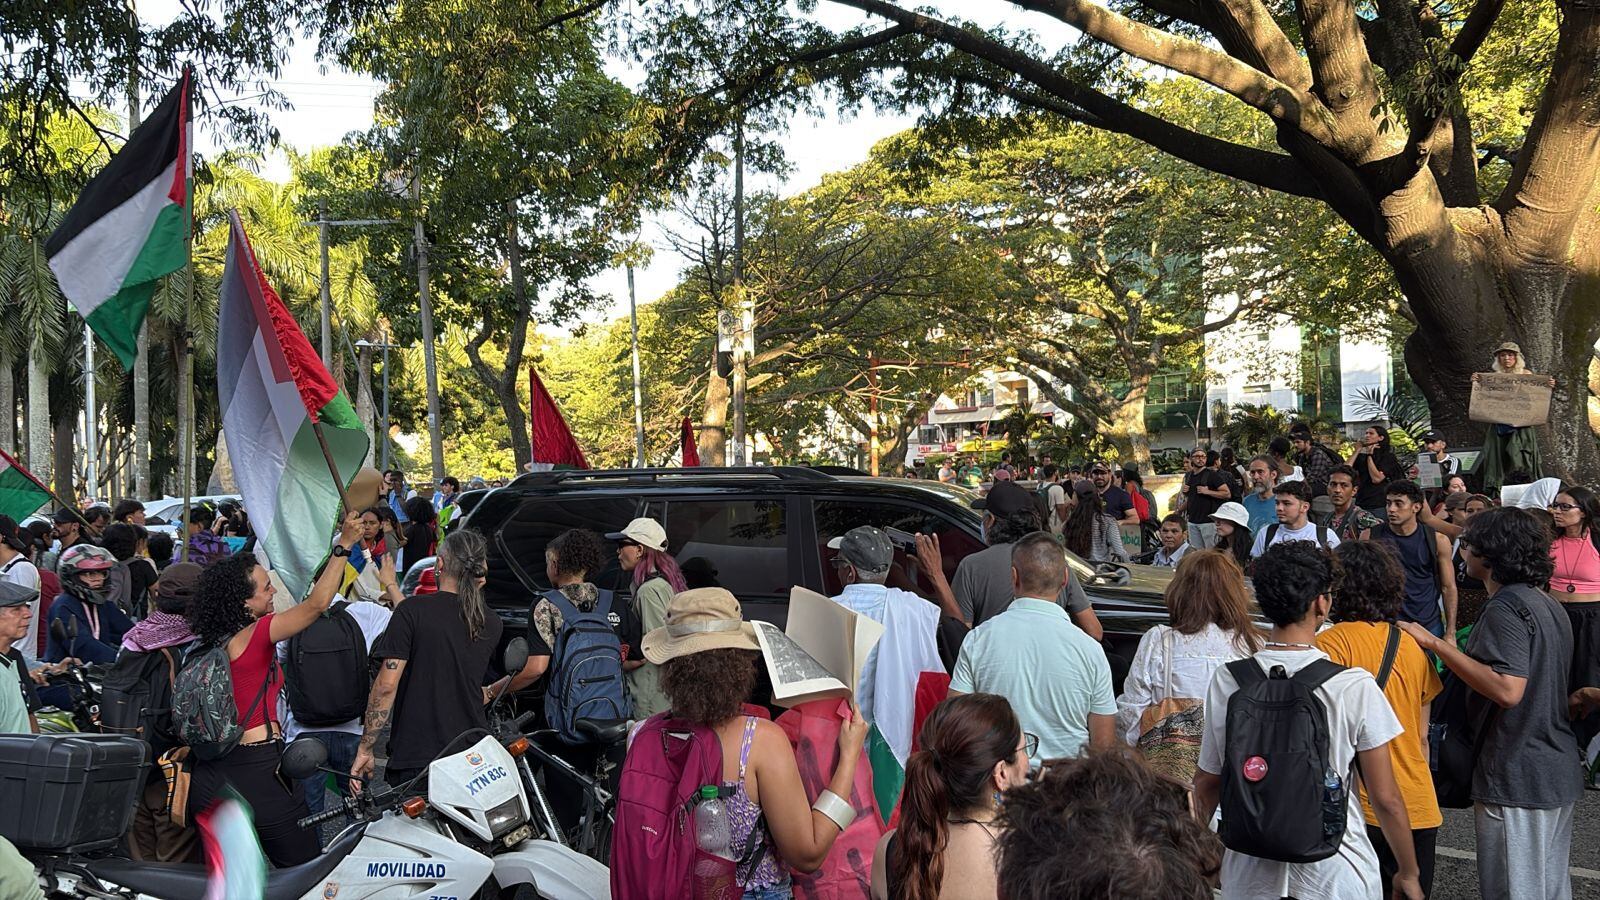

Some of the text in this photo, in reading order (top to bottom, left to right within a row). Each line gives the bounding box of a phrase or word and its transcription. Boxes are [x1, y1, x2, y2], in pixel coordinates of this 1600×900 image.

[466, 774, 491, 796] XTN
[487, 766, 507, 781] 83C
[367, 862, 446, 878] MOVILIDAD
